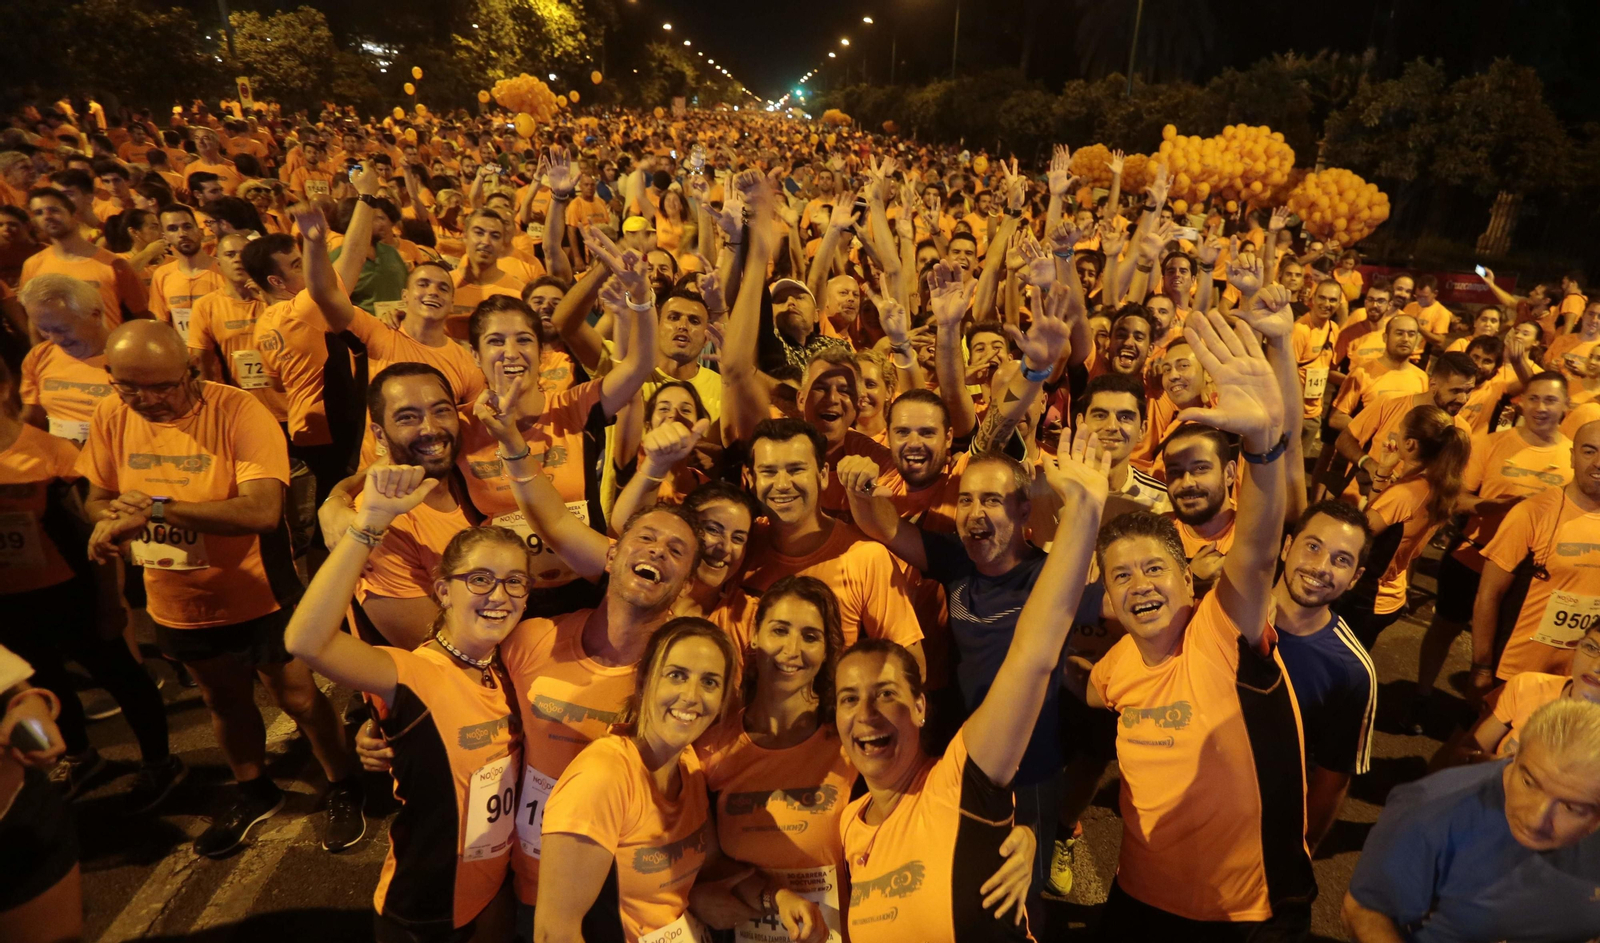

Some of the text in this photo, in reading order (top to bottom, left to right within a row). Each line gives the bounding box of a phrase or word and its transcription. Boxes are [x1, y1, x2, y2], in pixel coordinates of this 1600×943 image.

[244, 362, 263, 374] 72
[137, 524, 198, 544] 0060
[796, 871, 827, 880] CARRERA
[790, 878, 826, 886] NOCTURNA
